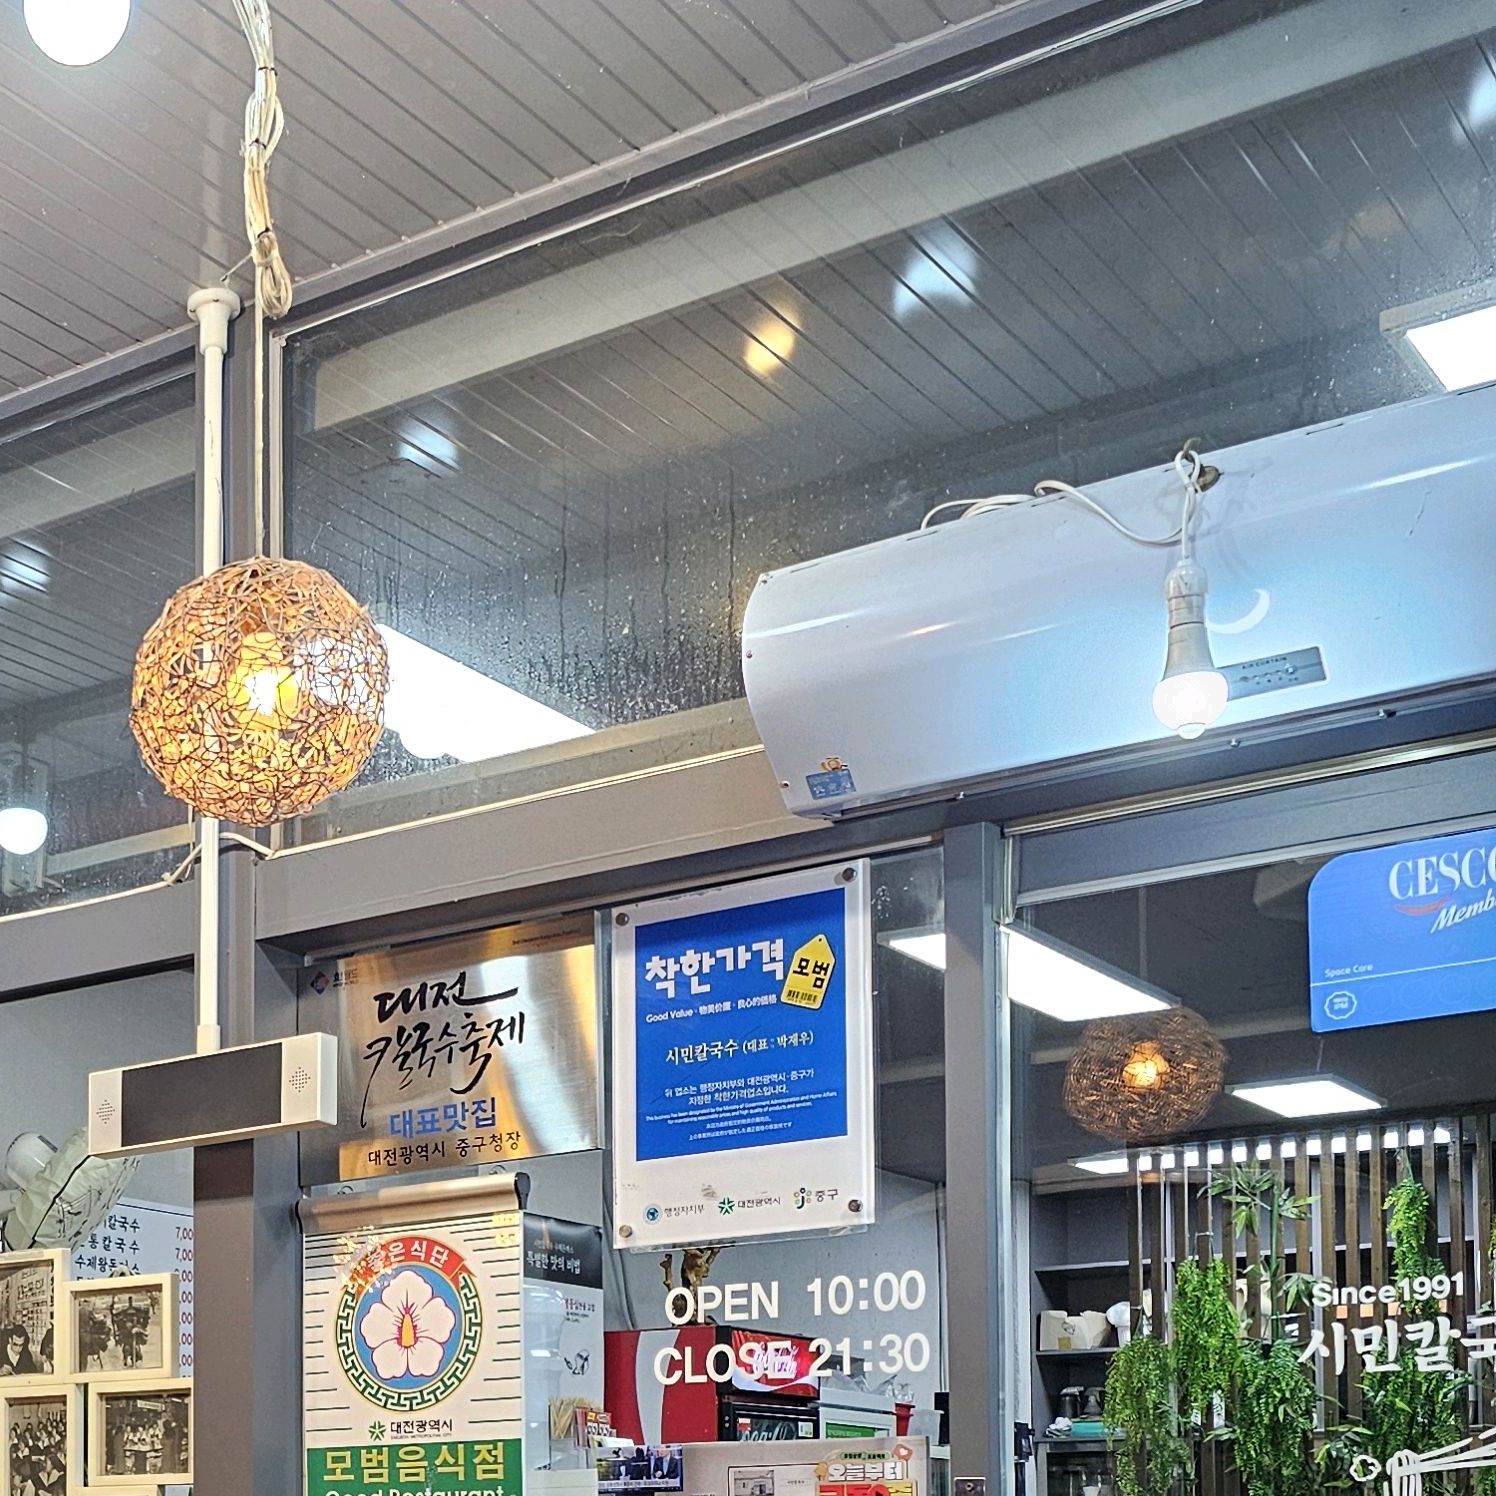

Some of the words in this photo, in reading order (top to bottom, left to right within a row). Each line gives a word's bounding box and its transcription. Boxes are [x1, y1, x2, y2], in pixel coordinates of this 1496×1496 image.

[645, 938, 784, 999] 착한가격
[792, 957, 830, 989] 모범
[1324, 967, 1351, 978] Space
[1353, 963, 1374, 973] Care
[374, 971, 519, 1023] 대전
[646, 1010, 669, 1023] Good
[670, 1007, 693, 1020] Value
[666, 1039, 739, 1066] 시민칼국수
[360, 1012, 525, 1128] 칼국수축제
[390, 1096, 497, 1138] 대표맛집
[368, 1141, 446, 1167] 대전광역시
[455, 1130, 521, 1157] 중구청장
[664, 1204, 704, 1217] 행정자치부
[738, 1197, 781, 1208] 대전광역시
[815, 1189, 838, 1202] 중구
[665, 1280, 779, 1326] OPEN
[806, 1270, 926, 1317] 10:00
[654, 1341, 792, 1386] CLOSE
[808, 1332, 931, 1377] 21:30
[390, 1419, 453, 1434] 대전광역시
[323, 1441, 504, 1483] 모범음식점
[828, 1461, 903, 1482] 오늘부터
